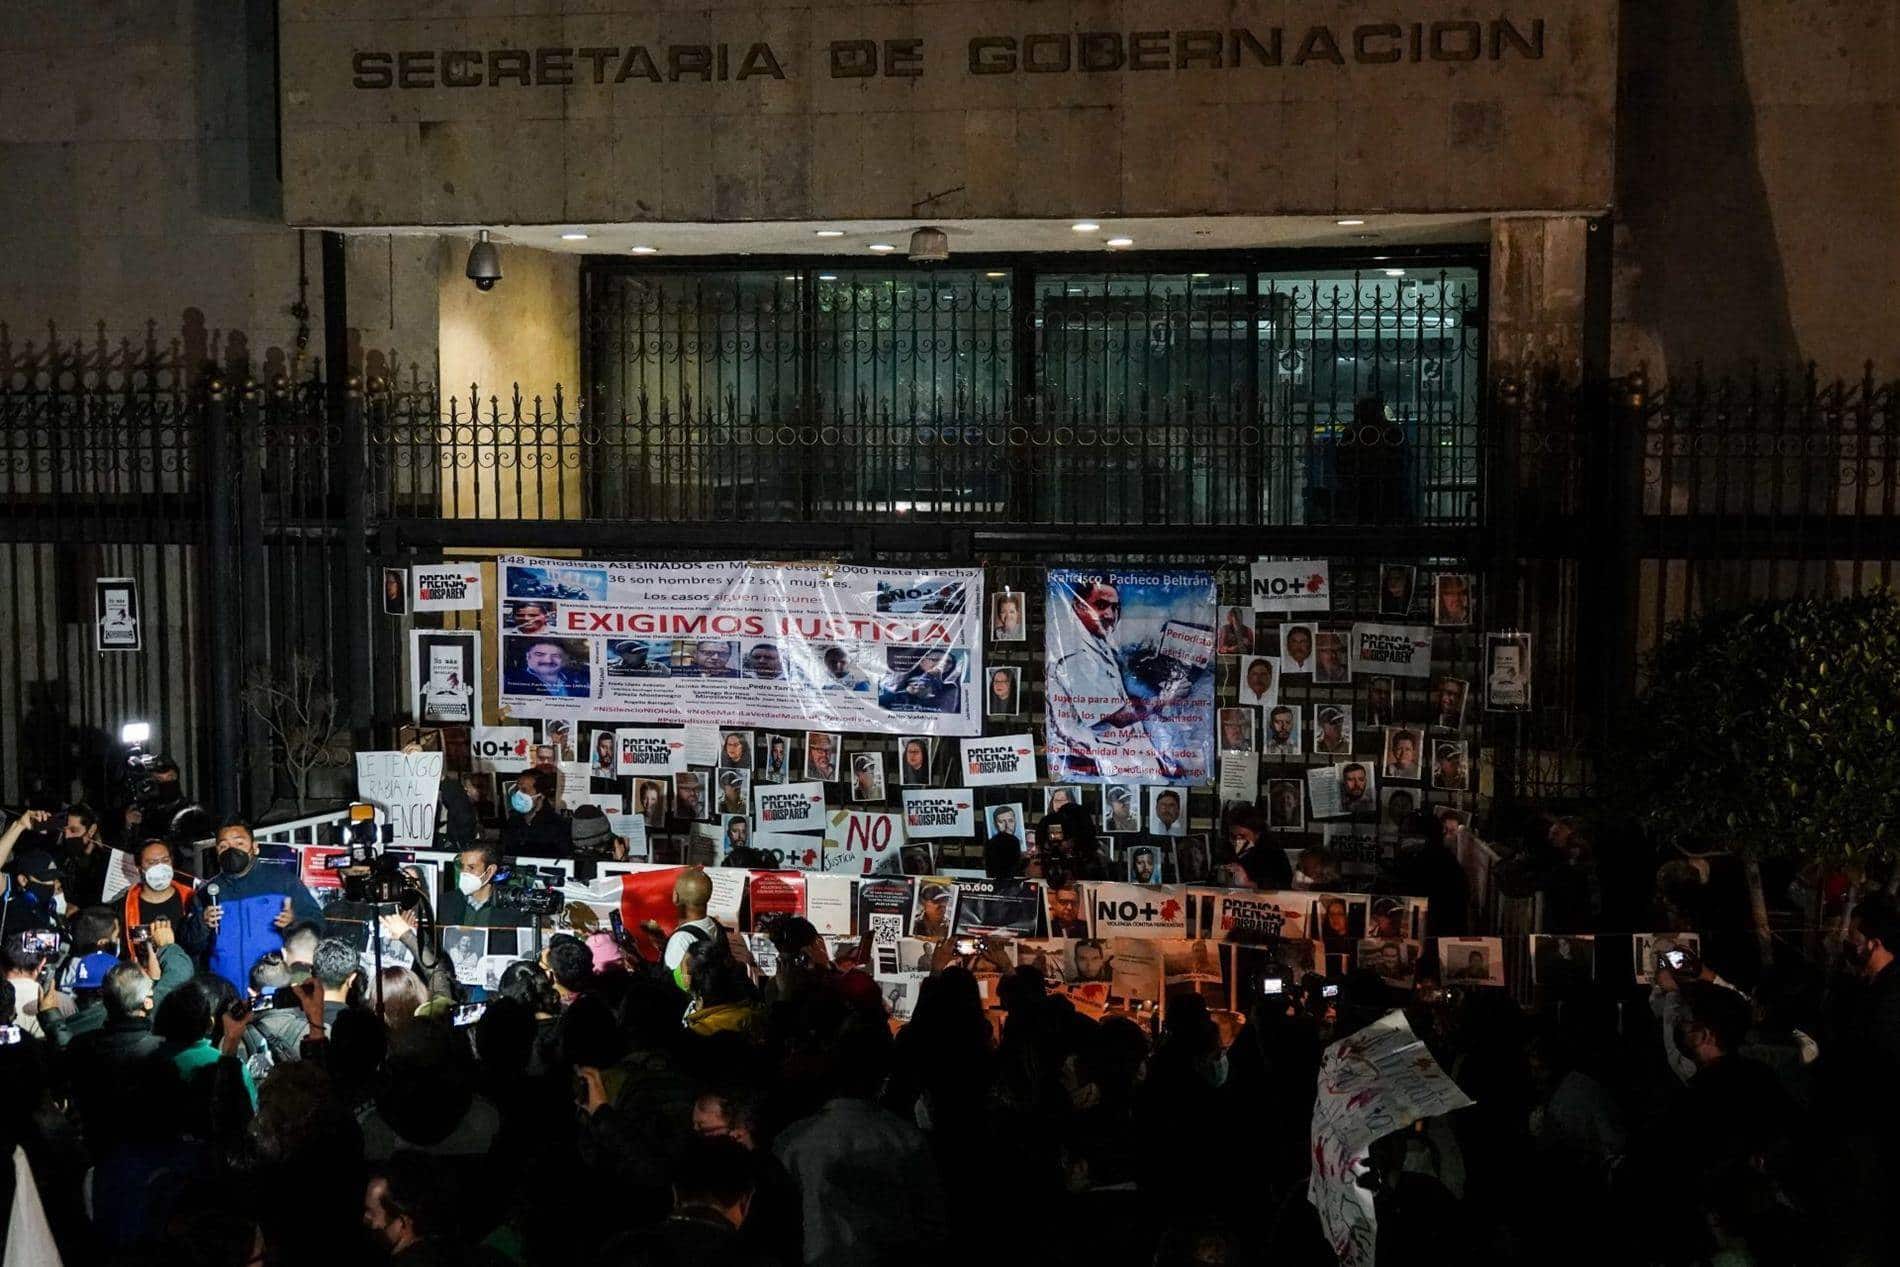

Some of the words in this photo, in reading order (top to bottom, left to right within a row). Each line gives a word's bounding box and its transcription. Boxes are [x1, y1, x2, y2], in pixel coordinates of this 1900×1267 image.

[352, 43, 786, 90] SECRETARIA
[830, 38, 924, 78] DE
[968, 18, 1545, 74] GOBERNACION
[529, 558, 605, 570] periodistas
[609, 561, 703, 571] ASESINADOS
[834, 564, 868, 575] 2000
[872, 566, 912, 577] hasta
[419, 574, 467, 591] PRENSA,
[608, 574, 625, 583] 36
[630, 576, 654, 584] son
[658, 575, 722, 585] hombres
[726, 578, 735, 586] y
[1110, 574, 1160, 586] Pacheco
[1163, 575, 1208, 586] Beltrán
[1254, 577, 1304, 595] NO+
[644, 592, 666, 601] Los
[568, 612, 764, 634] EXIGIMOS
[780, 617, 953, 643] JUSTICIA
[1360, 632, 1415, 654] PRENSA,
[1088, 695, 1110, 705] para
[1082, 710, 1095, 720] los
[622, 738, 672, 756] PRENSA,
[968, 746, 1020, 763] PRENSA,
[1070, 748, 1118, 756] mpunidad
[360, 754, 376, 778] LE
[384, 754, 442, 778] TENGO
[407, 780, 424, 797] AL
[761, 793, 812, 812] PRENSA,
[906, 799, 958, 816] PRENSA,
[846, 816, 892, 852] NO
[1098, 900, 1158, 922] NO+
[1222, 898, 1285, 926] PRENSA,
